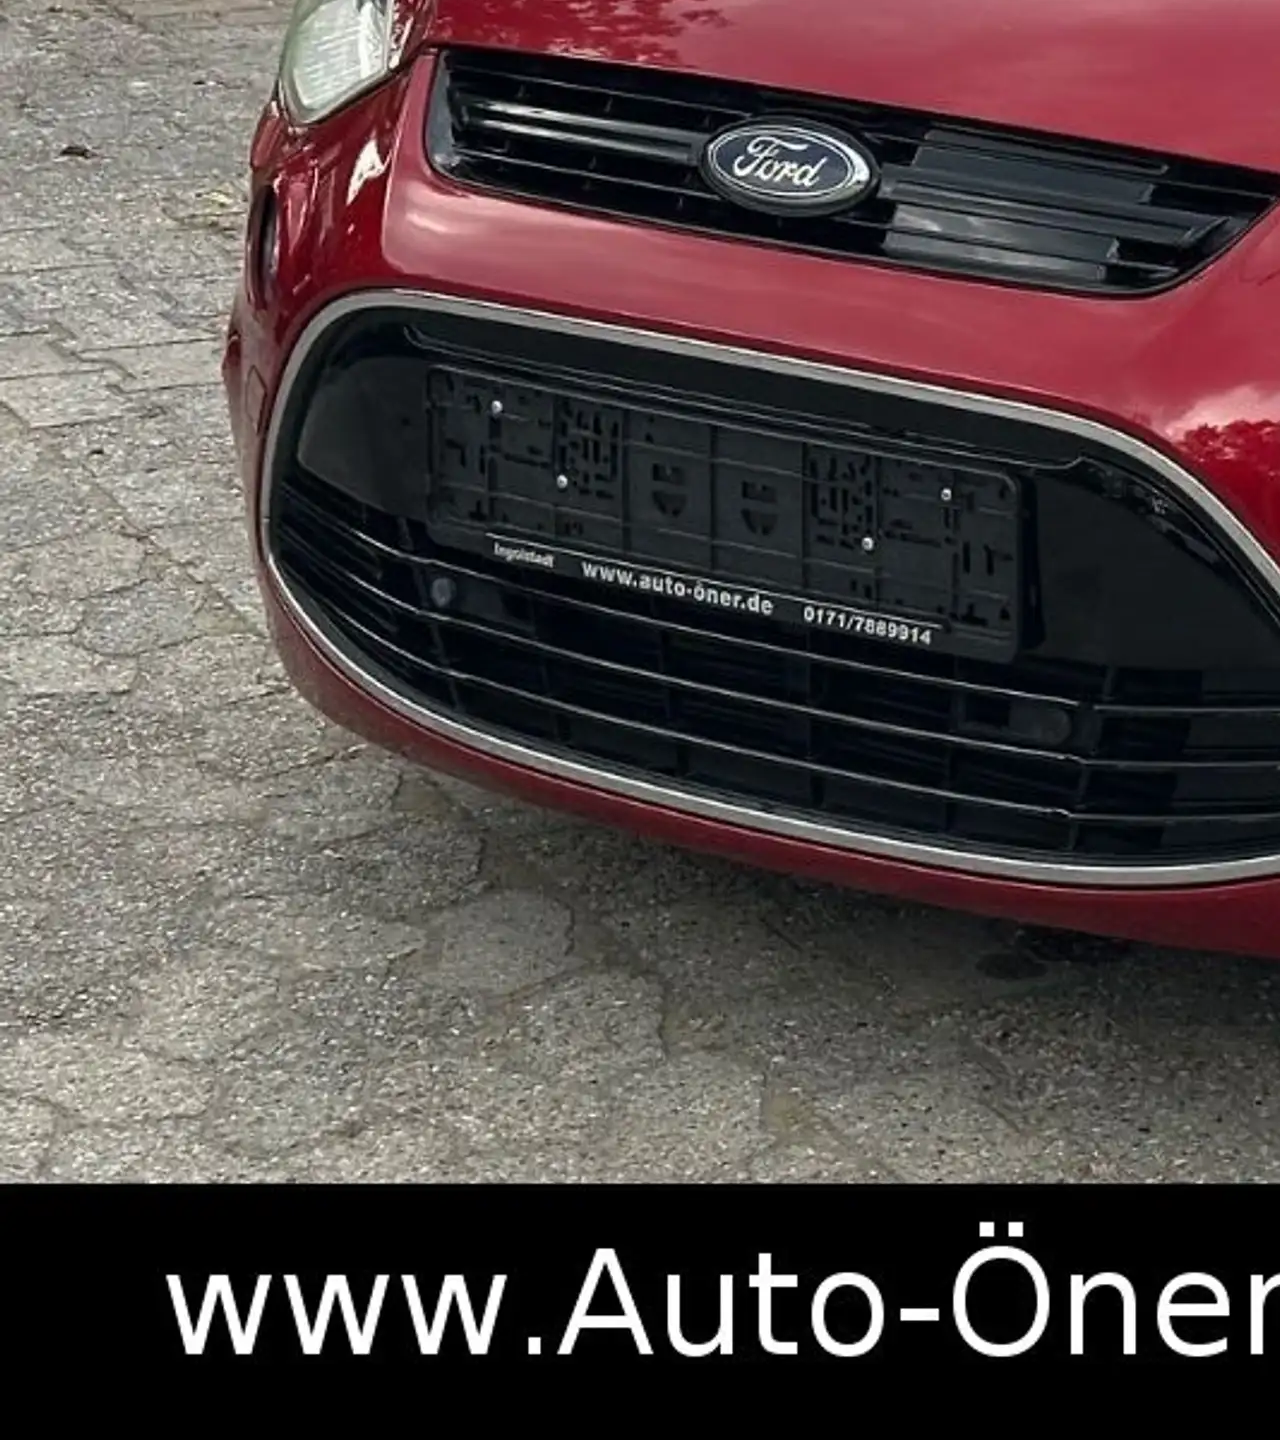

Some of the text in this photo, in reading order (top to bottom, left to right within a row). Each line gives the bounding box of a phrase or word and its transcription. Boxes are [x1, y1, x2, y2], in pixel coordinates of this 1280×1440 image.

[733, 135, 829, 187] Ford
[581, 560, 775, 616] www.auto-öner.de
[803, 606, 932, 646] 0171/7889914
